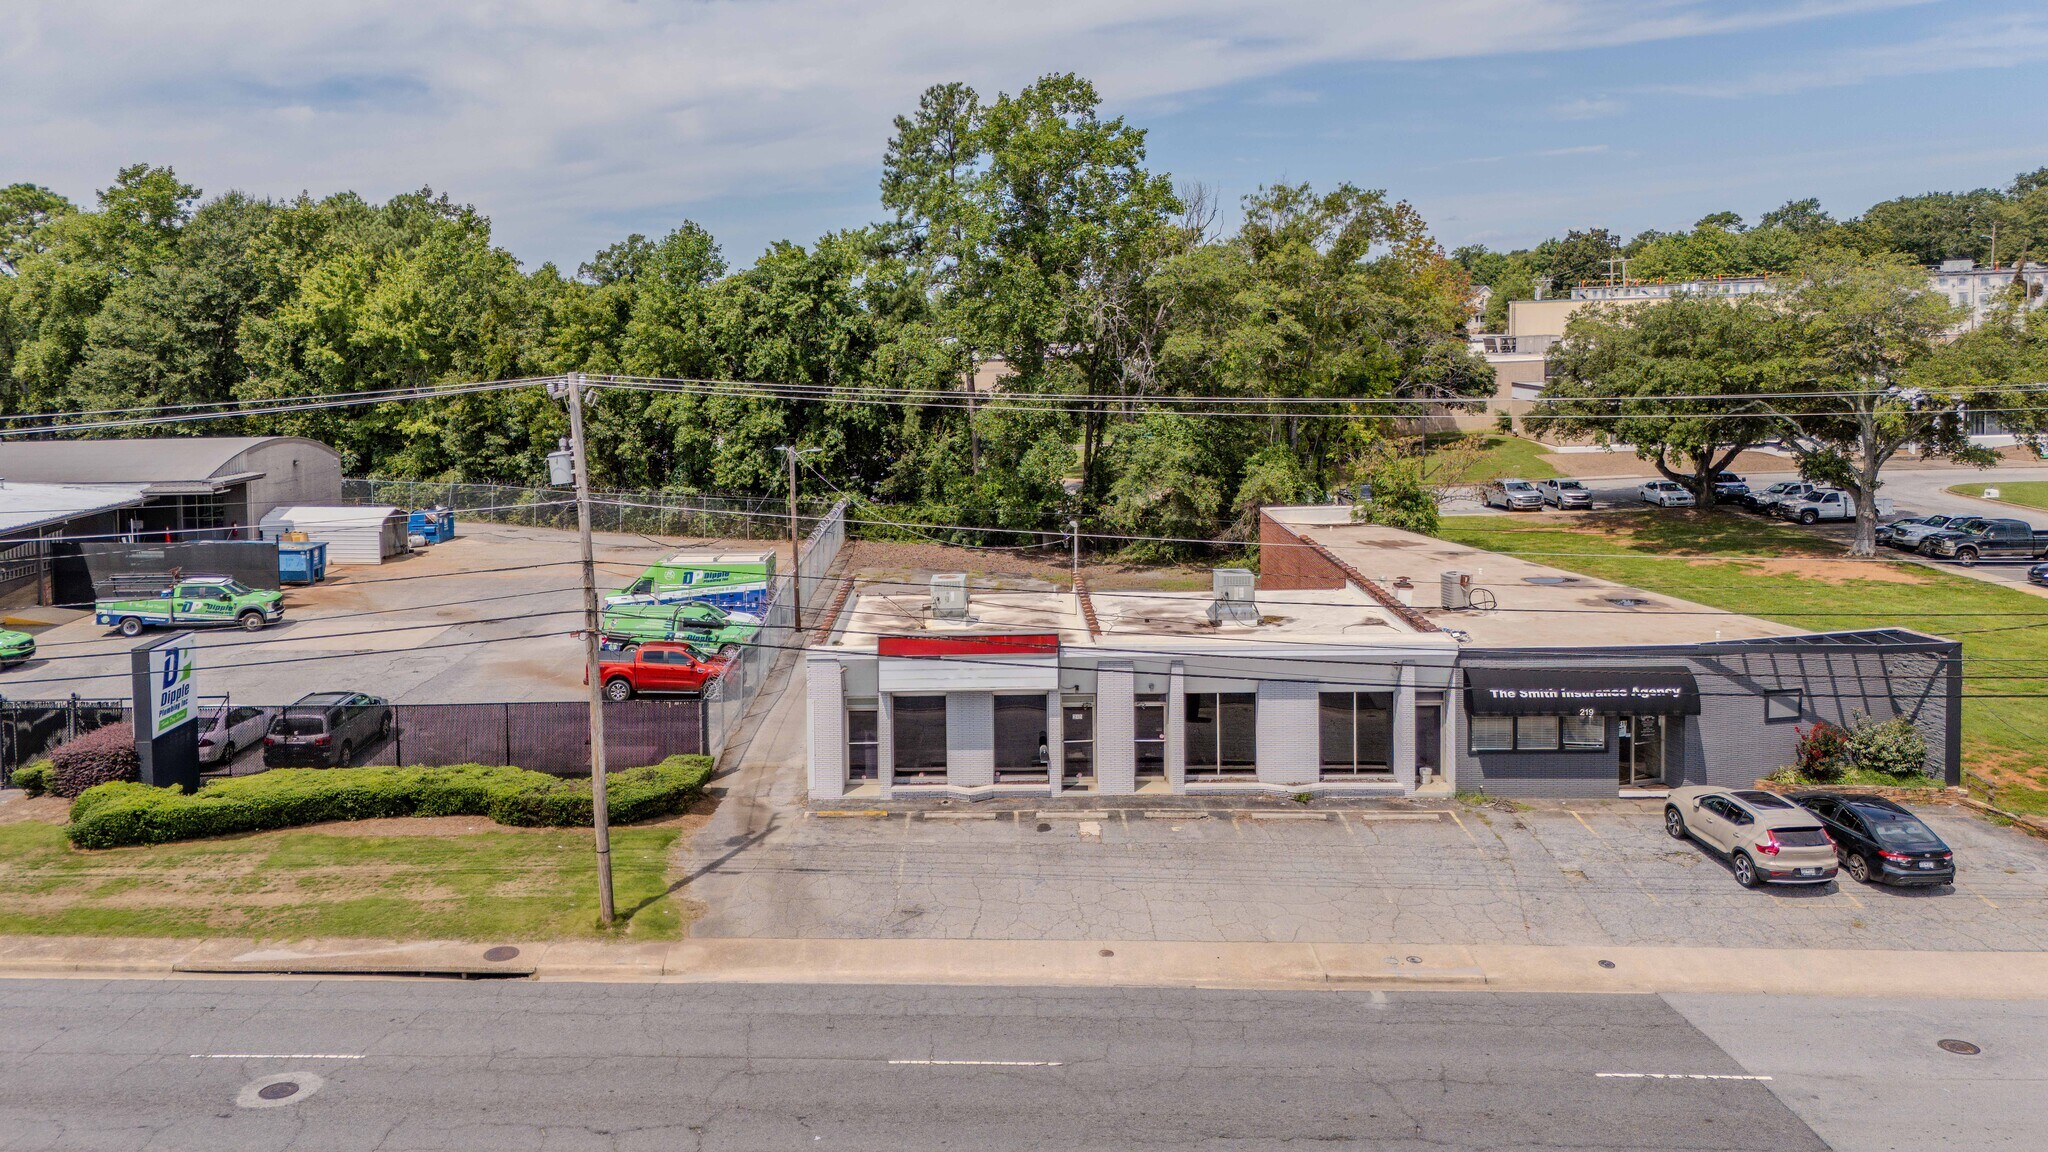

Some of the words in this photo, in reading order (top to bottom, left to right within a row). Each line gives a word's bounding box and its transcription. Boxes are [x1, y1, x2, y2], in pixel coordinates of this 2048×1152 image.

[160, 683, 190, 707] Dipple
[1489, 689, 1516, 698] The
[1519, 688, 1558, 698] Smith
[1630, 687, 1681, 698] Agency
[1579, 708, 1594, 716] 219
